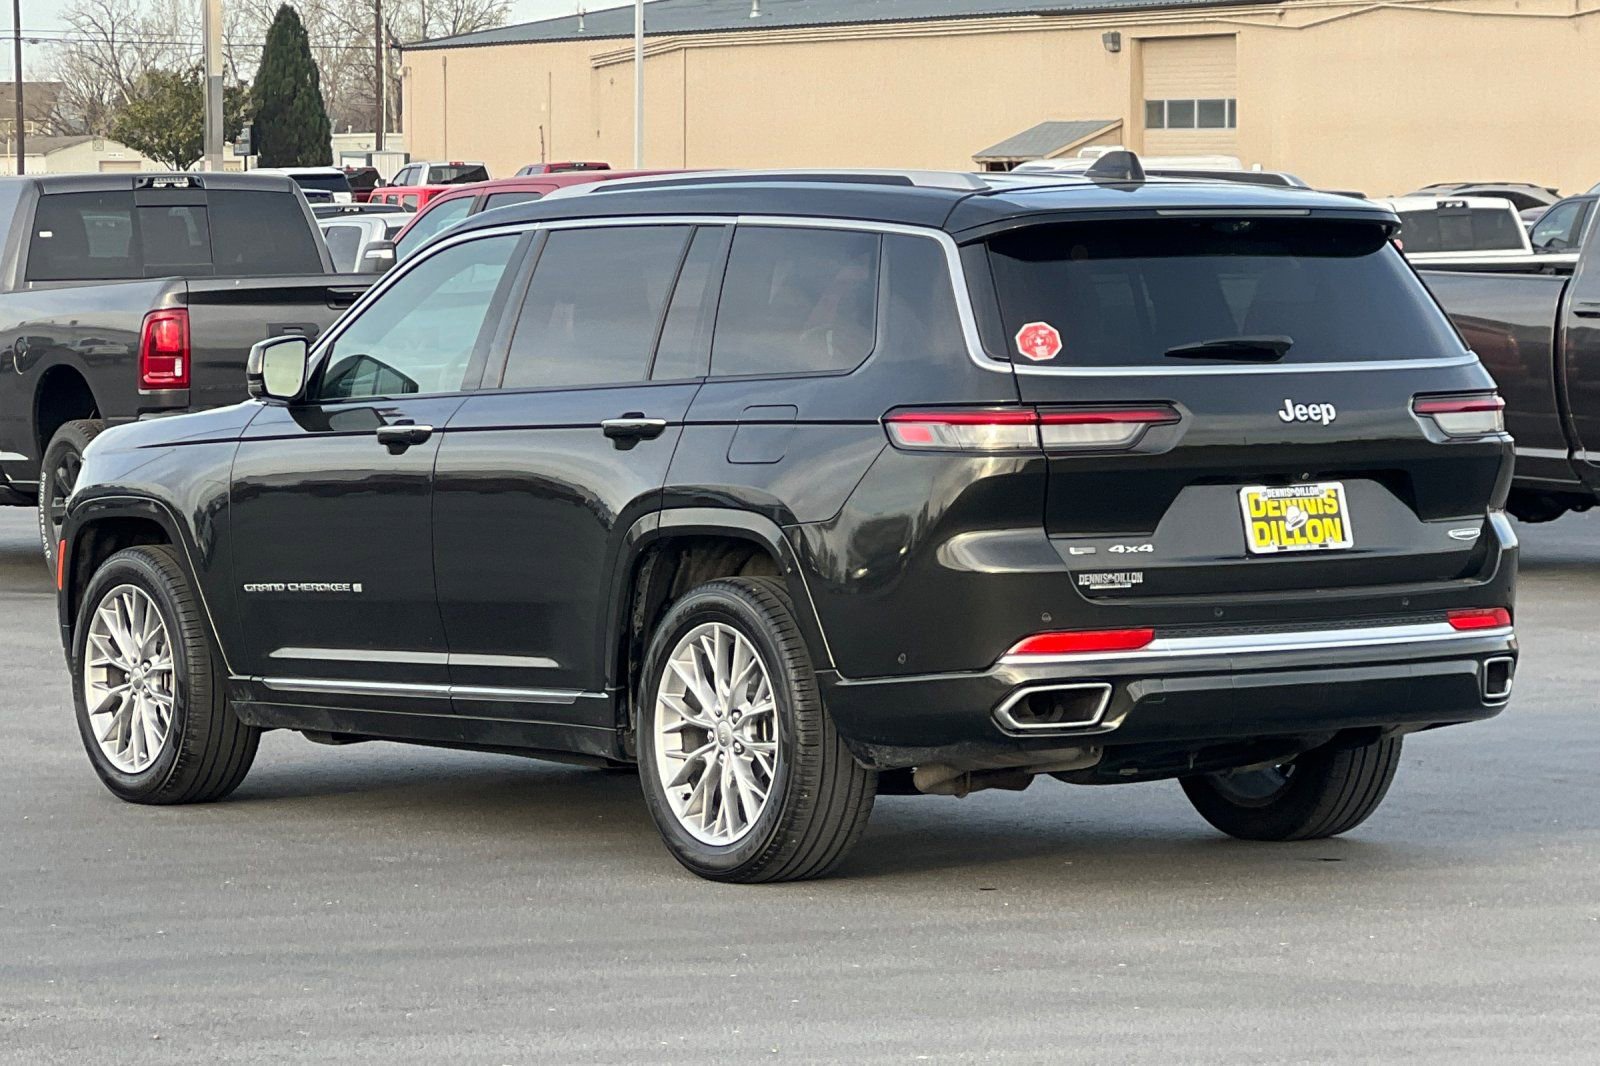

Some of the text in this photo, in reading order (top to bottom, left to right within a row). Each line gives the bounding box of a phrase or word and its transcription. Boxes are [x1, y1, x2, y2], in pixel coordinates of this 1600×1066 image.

[1278, 399, 1336, 425] Jeep
[1252, 518, 1342, 547] DILLON
[1108, 544, 1154, 553] 4x4
[1078, 572, 1143, 585] DENNIS DILLON
[243, 583, 285, 591] GRAND
[287, 583, 351, 591] CHEROKEE
